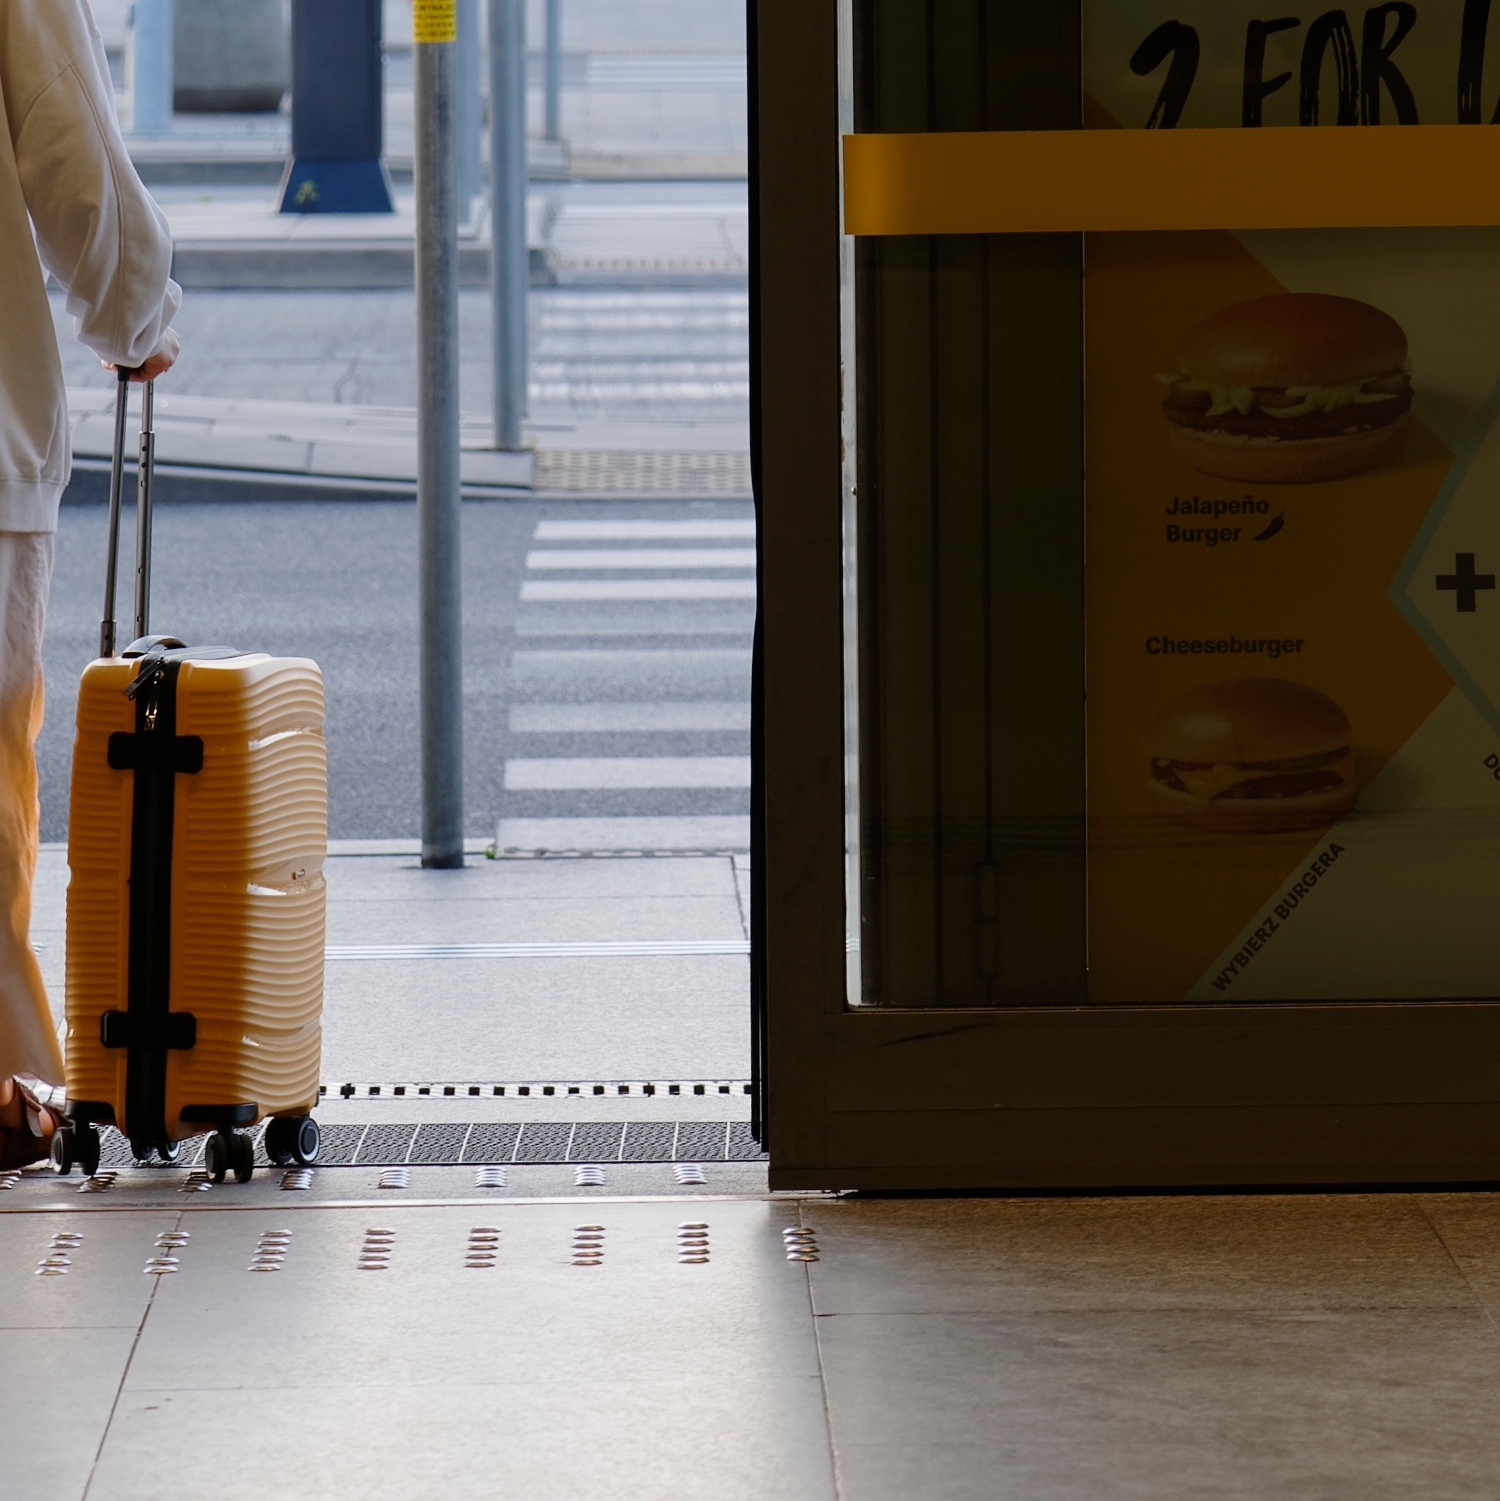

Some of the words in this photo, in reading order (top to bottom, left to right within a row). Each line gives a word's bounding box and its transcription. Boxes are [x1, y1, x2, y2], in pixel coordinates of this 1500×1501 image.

[1130, 19, 1200, 129] 2
[1242, 1, 1418, 128] FOR
[1165, 494, 1269, 517] Jalapeño
[1166, 524, 1242, 547] Burger
[1144, 635, 1304, 659] Cheeseburger
[1211, 916, 1280, 991] WYBIERZ
[1274, 843, 1345, 920] BURGERA
